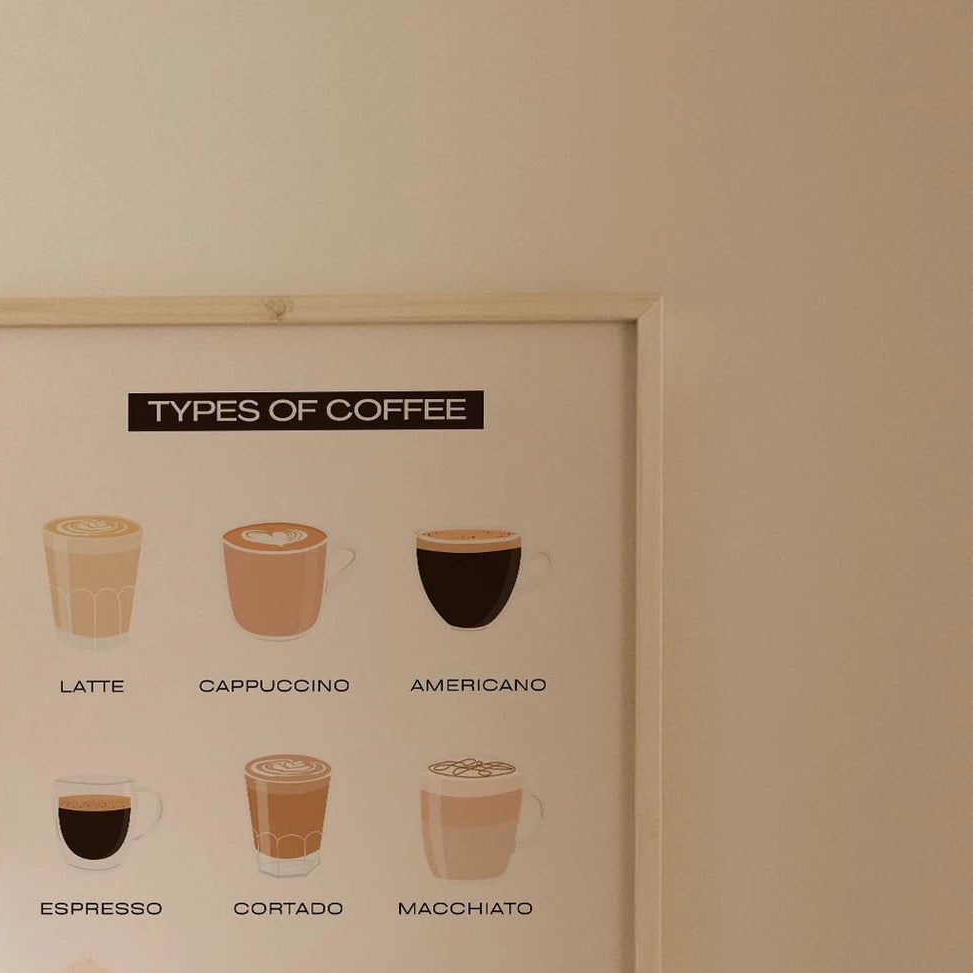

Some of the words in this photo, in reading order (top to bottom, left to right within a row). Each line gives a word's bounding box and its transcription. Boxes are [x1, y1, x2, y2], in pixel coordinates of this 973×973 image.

[147, 399, 261, 422] TYPES
[268, 398, 318, 422] OF
[326, 398, 467, 422] COFFEE
[60, 679, 125, 694] LATTE
[199, 678, 350, 693] CAPPUCCINO
[410, 678, 547, 692] AMERICANO
[40, 902, 163, 916] ESPRESSO
[233, 902, 343, 916] CORTADO
[398, 901, 533, 916] MACCHIATO
